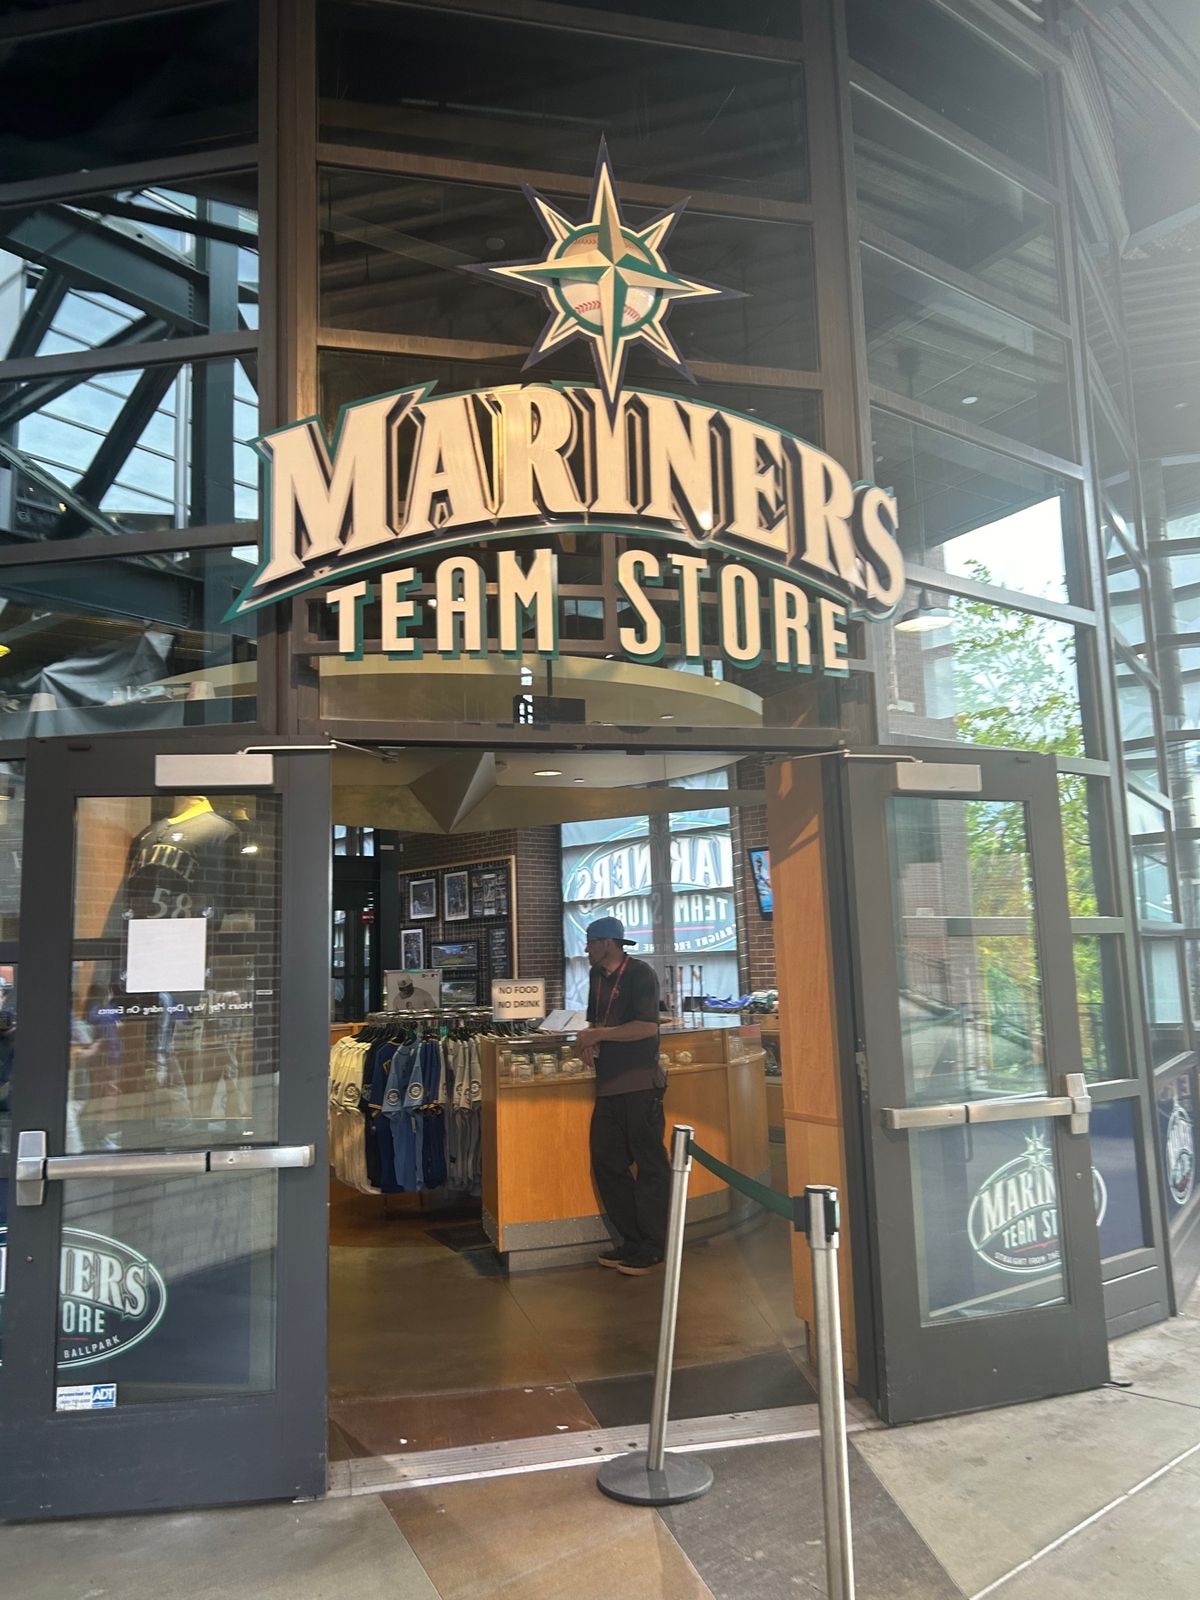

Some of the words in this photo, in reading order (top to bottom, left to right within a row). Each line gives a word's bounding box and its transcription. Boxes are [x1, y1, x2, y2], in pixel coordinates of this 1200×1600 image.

[252, 382, 904, 609] MARINERS
[325, 548, 557, 657] TEAM
[617, 549, 850, 671] STORE
[498, 986, 512, 995] NO
[514, 985, 539, 994] FOOD
[497, 1000, 511, 1009] NO
[513, 1000, 540, 1008] DRINK
[1002, 1214, 1037, 1249] TEAM
[63, 1334, 121, 1359] BALLPARK
[92, 1388, 115, 1400] ADT
